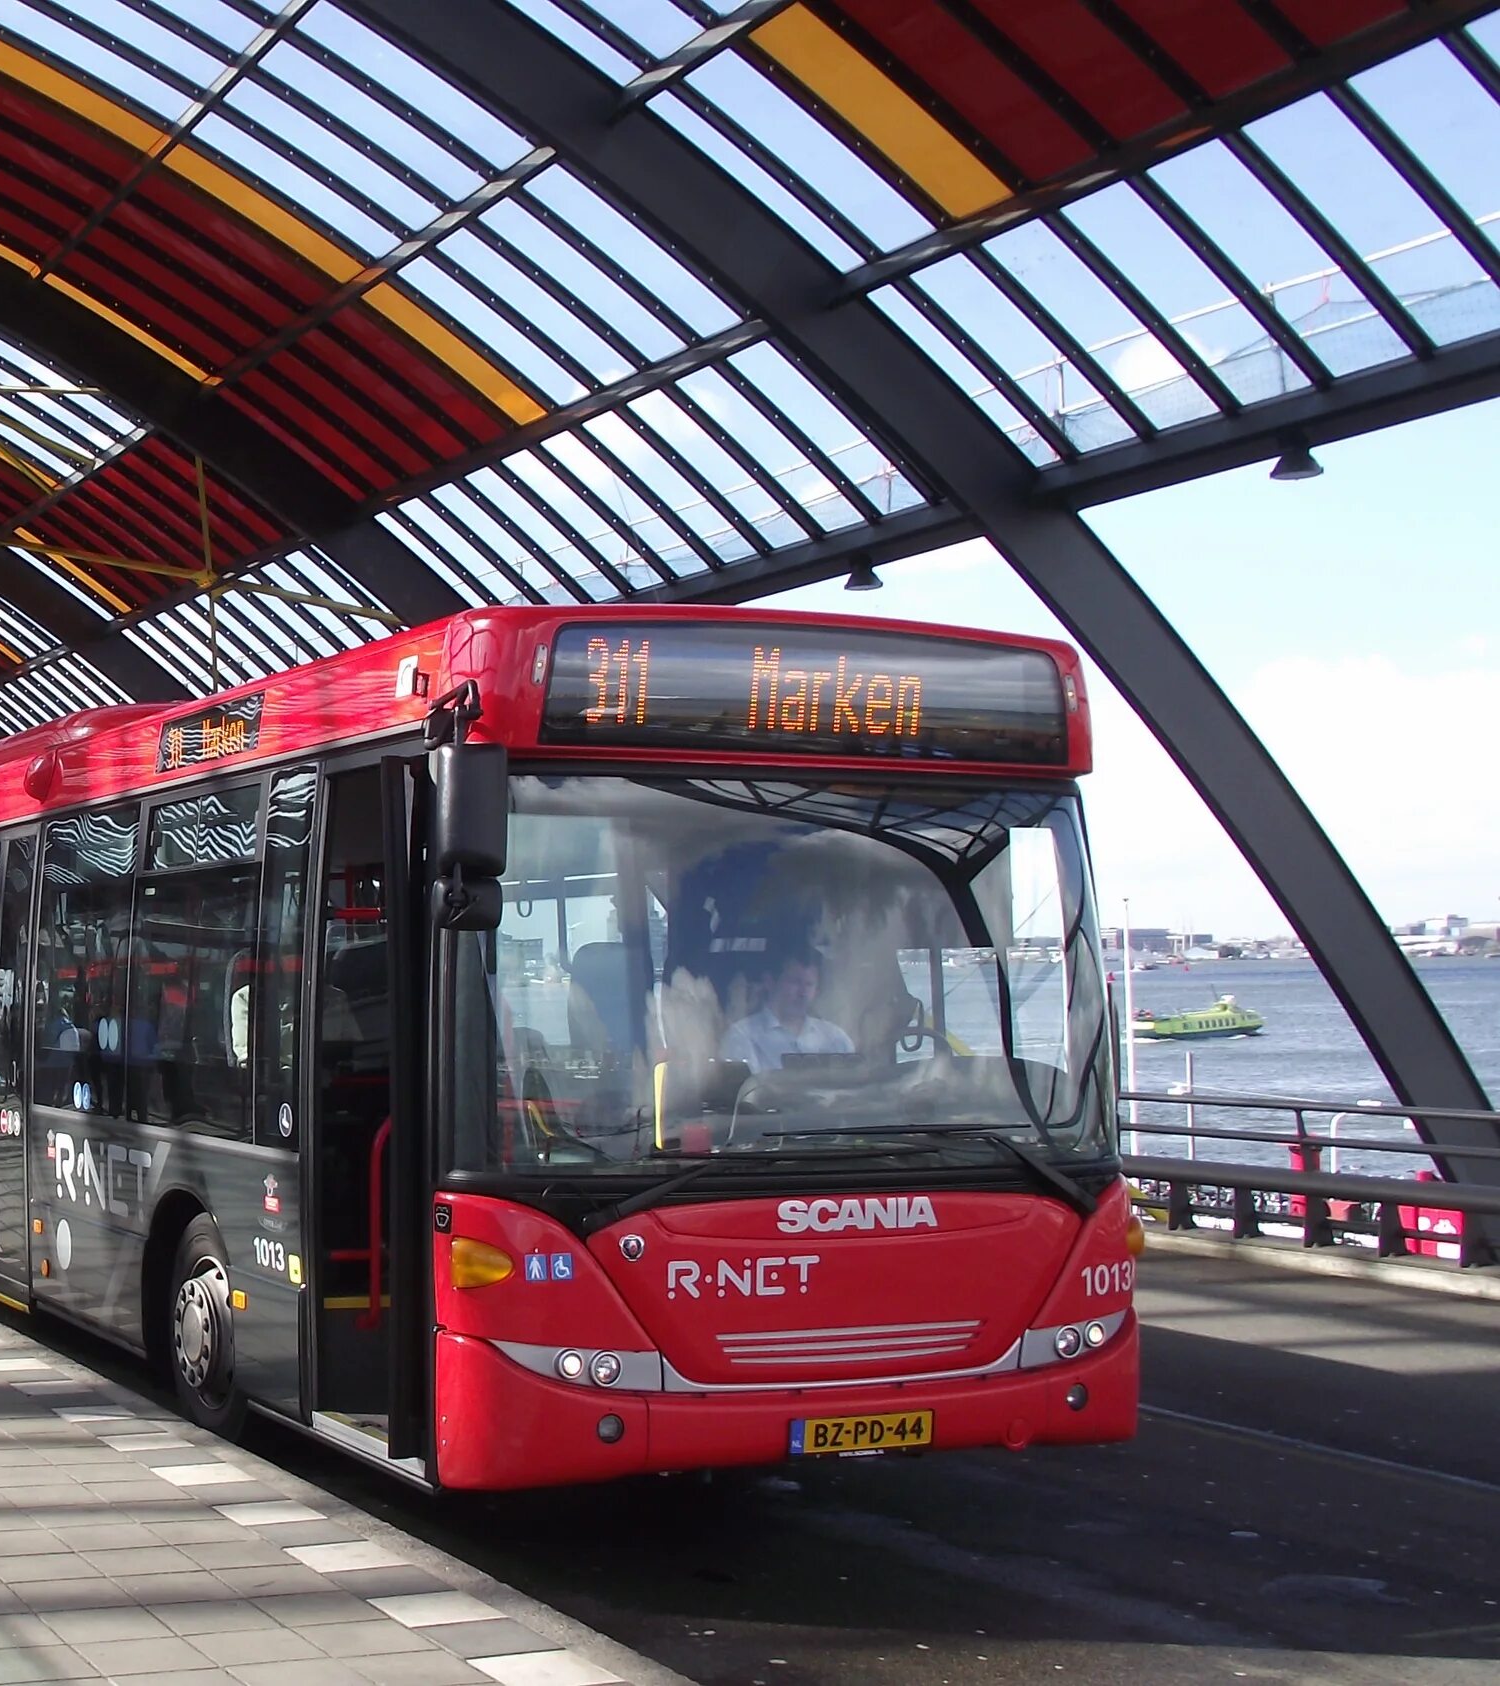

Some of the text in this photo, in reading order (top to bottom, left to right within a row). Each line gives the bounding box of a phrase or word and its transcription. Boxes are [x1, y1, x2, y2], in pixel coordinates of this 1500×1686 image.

[587, 637, 921, 736] 311 Marken
[776, 1196, 938, 1233] SCANIA
[253, 1236, 285, 1272] 1013
[1081, 1260, 1132, 1297] 1013
[813, 1416, 924, 1448] BZ-PD-44
